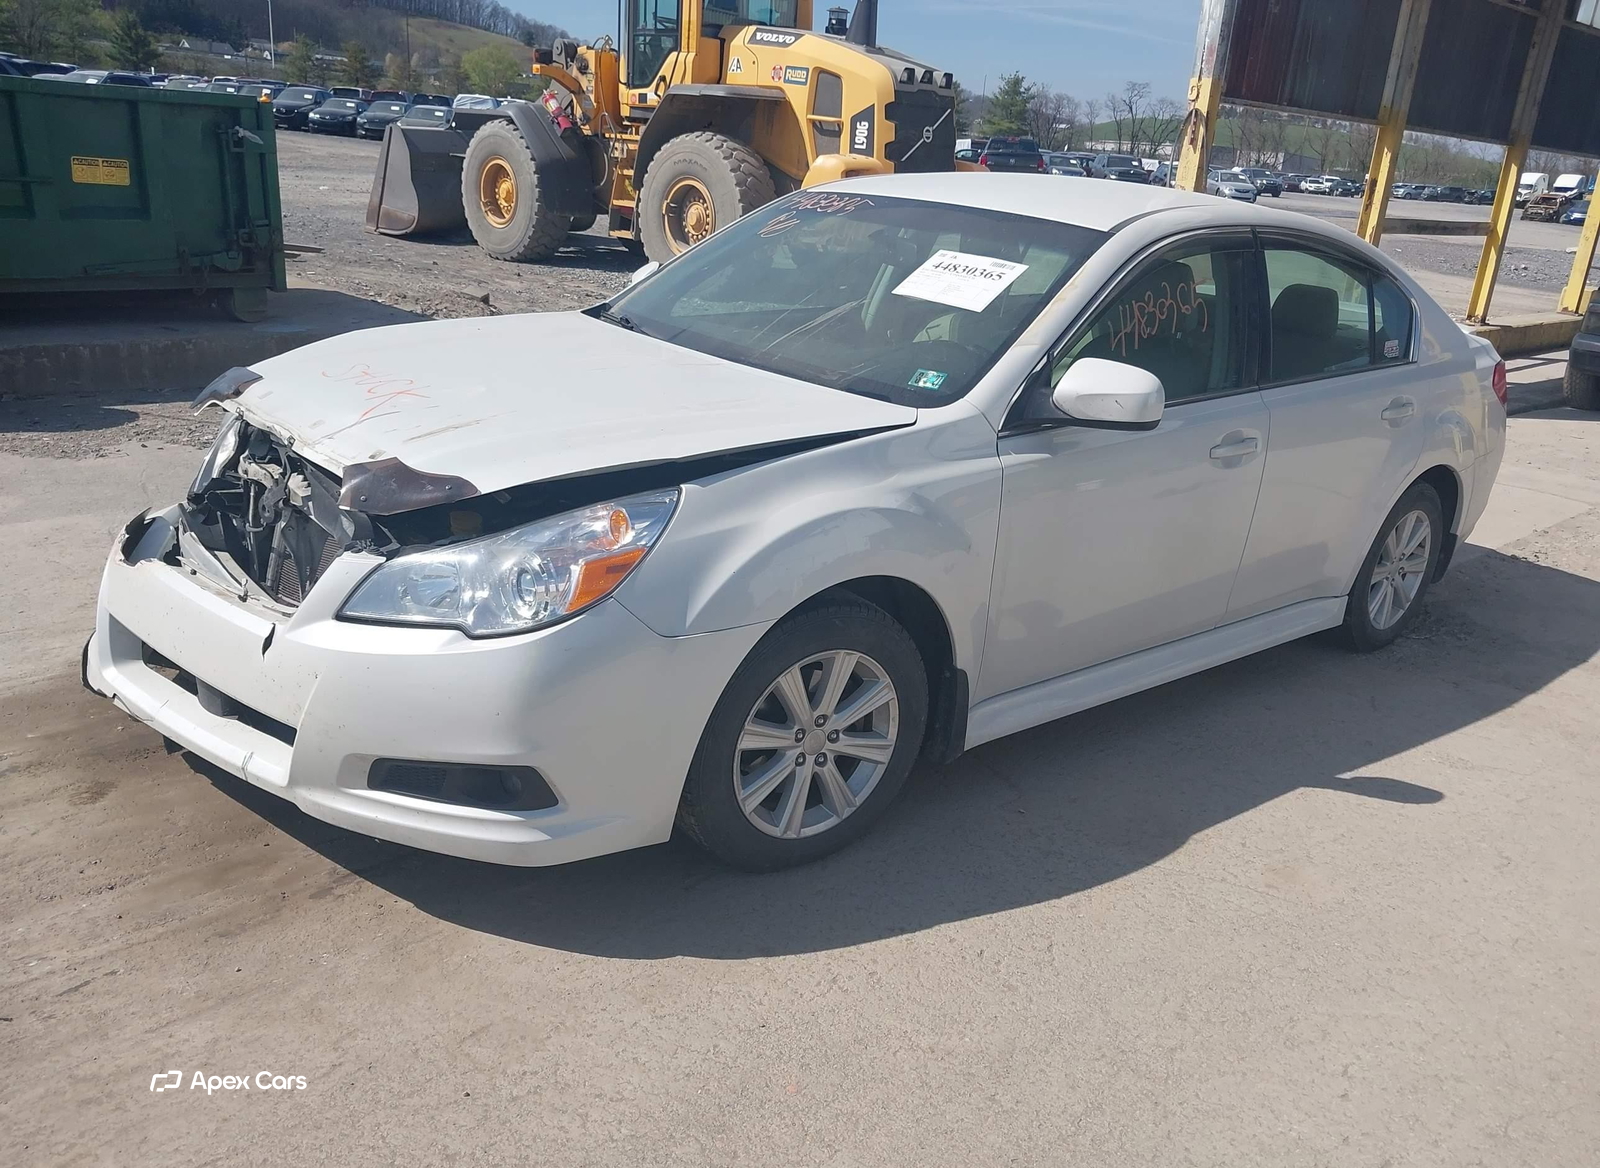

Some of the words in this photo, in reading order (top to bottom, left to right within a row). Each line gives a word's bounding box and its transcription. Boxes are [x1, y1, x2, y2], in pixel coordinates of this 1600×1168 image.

[755, 32, 795, 44] VOLVO
[785, 69, 807, 82] RUDD
[854, 121, 869, 149] L90G
[931, 261, 1007, 282] 44830365
